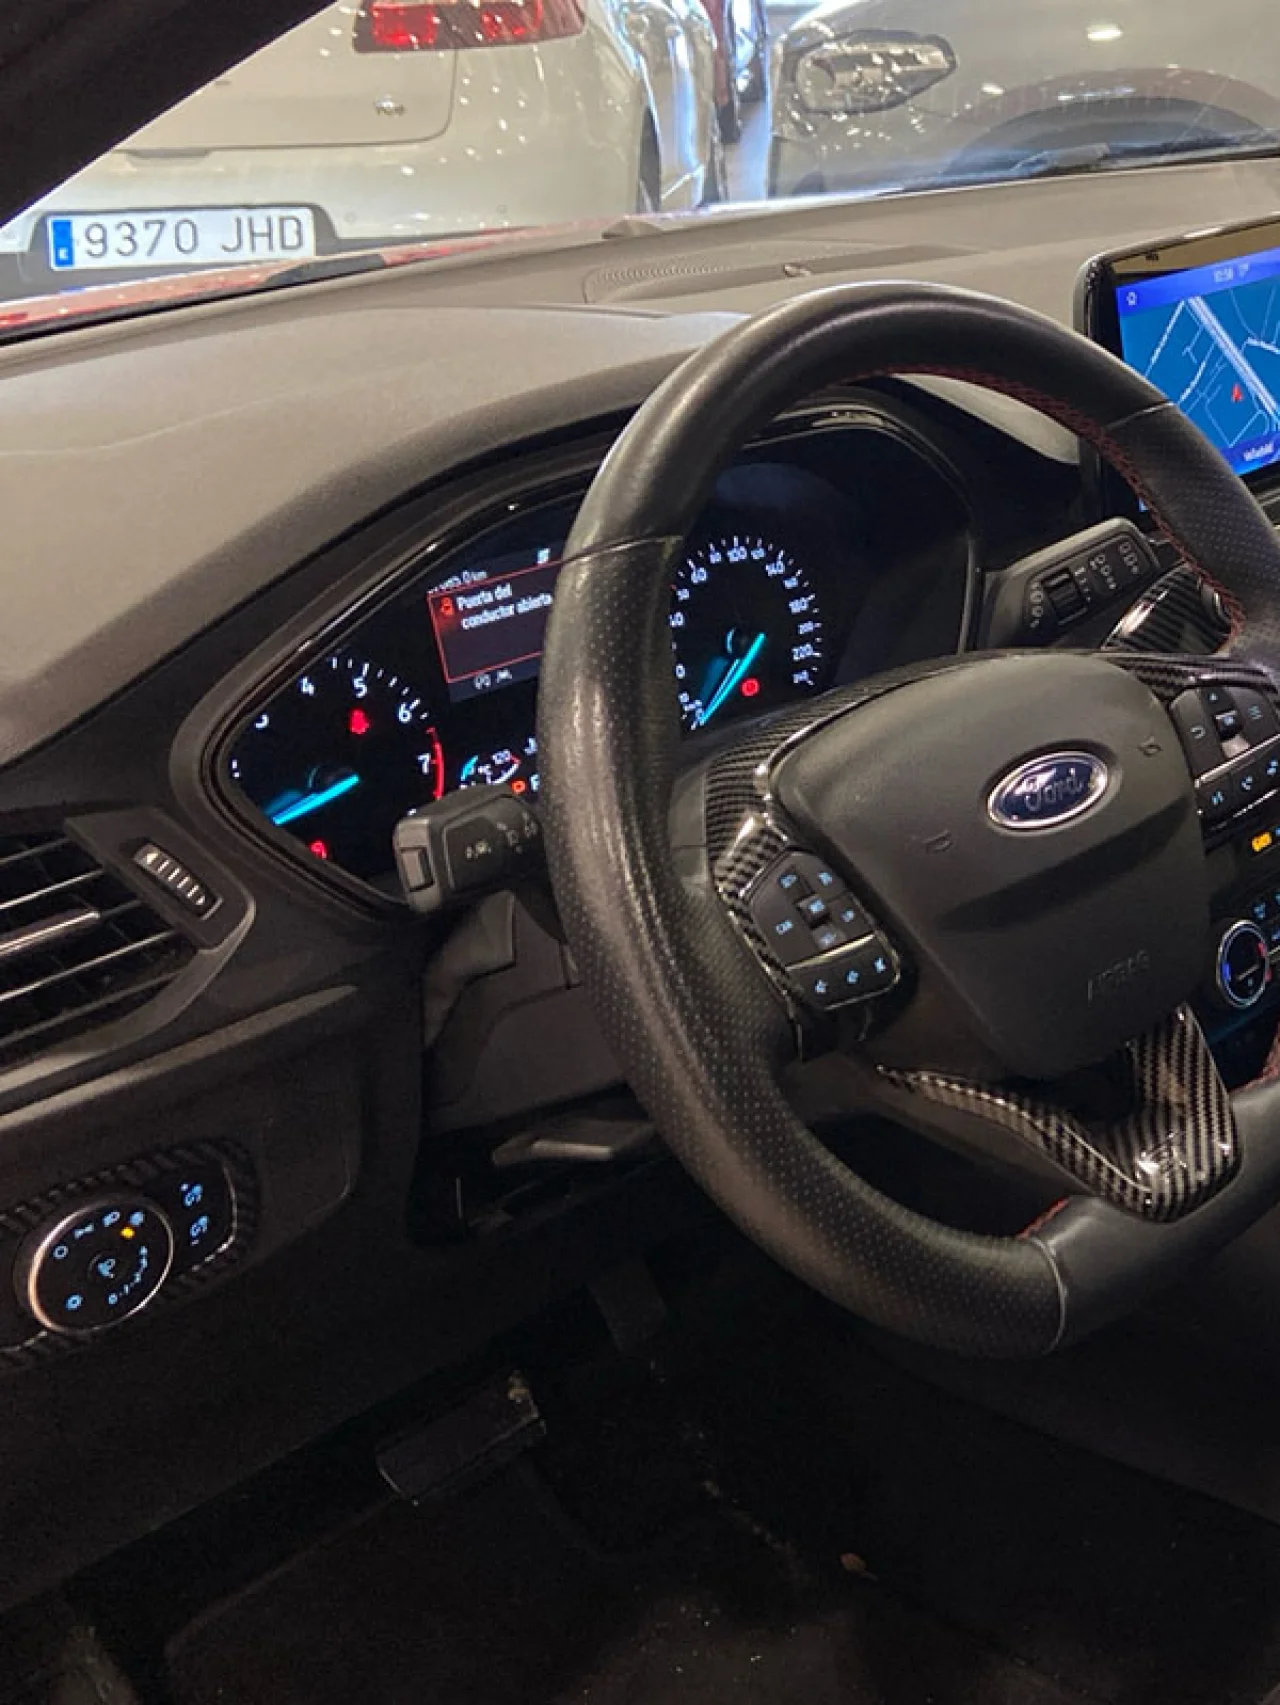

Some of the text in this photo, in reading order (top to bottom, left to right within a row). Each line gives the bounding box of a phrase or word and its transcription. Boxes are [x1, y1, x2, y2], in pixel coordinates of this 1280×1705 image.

[84, 215, 304, 258] 9370 JHD
[494, 582, 512, 600] del
[461, 604, 515, 630] conductor
[301, 675, 315, 696] 4
[353, 676, 367, 698] 5
[398, 702, 413, 723] 6
[417, 752, 432, 774] 7
[1011, 766, 1088, 813] Ford
